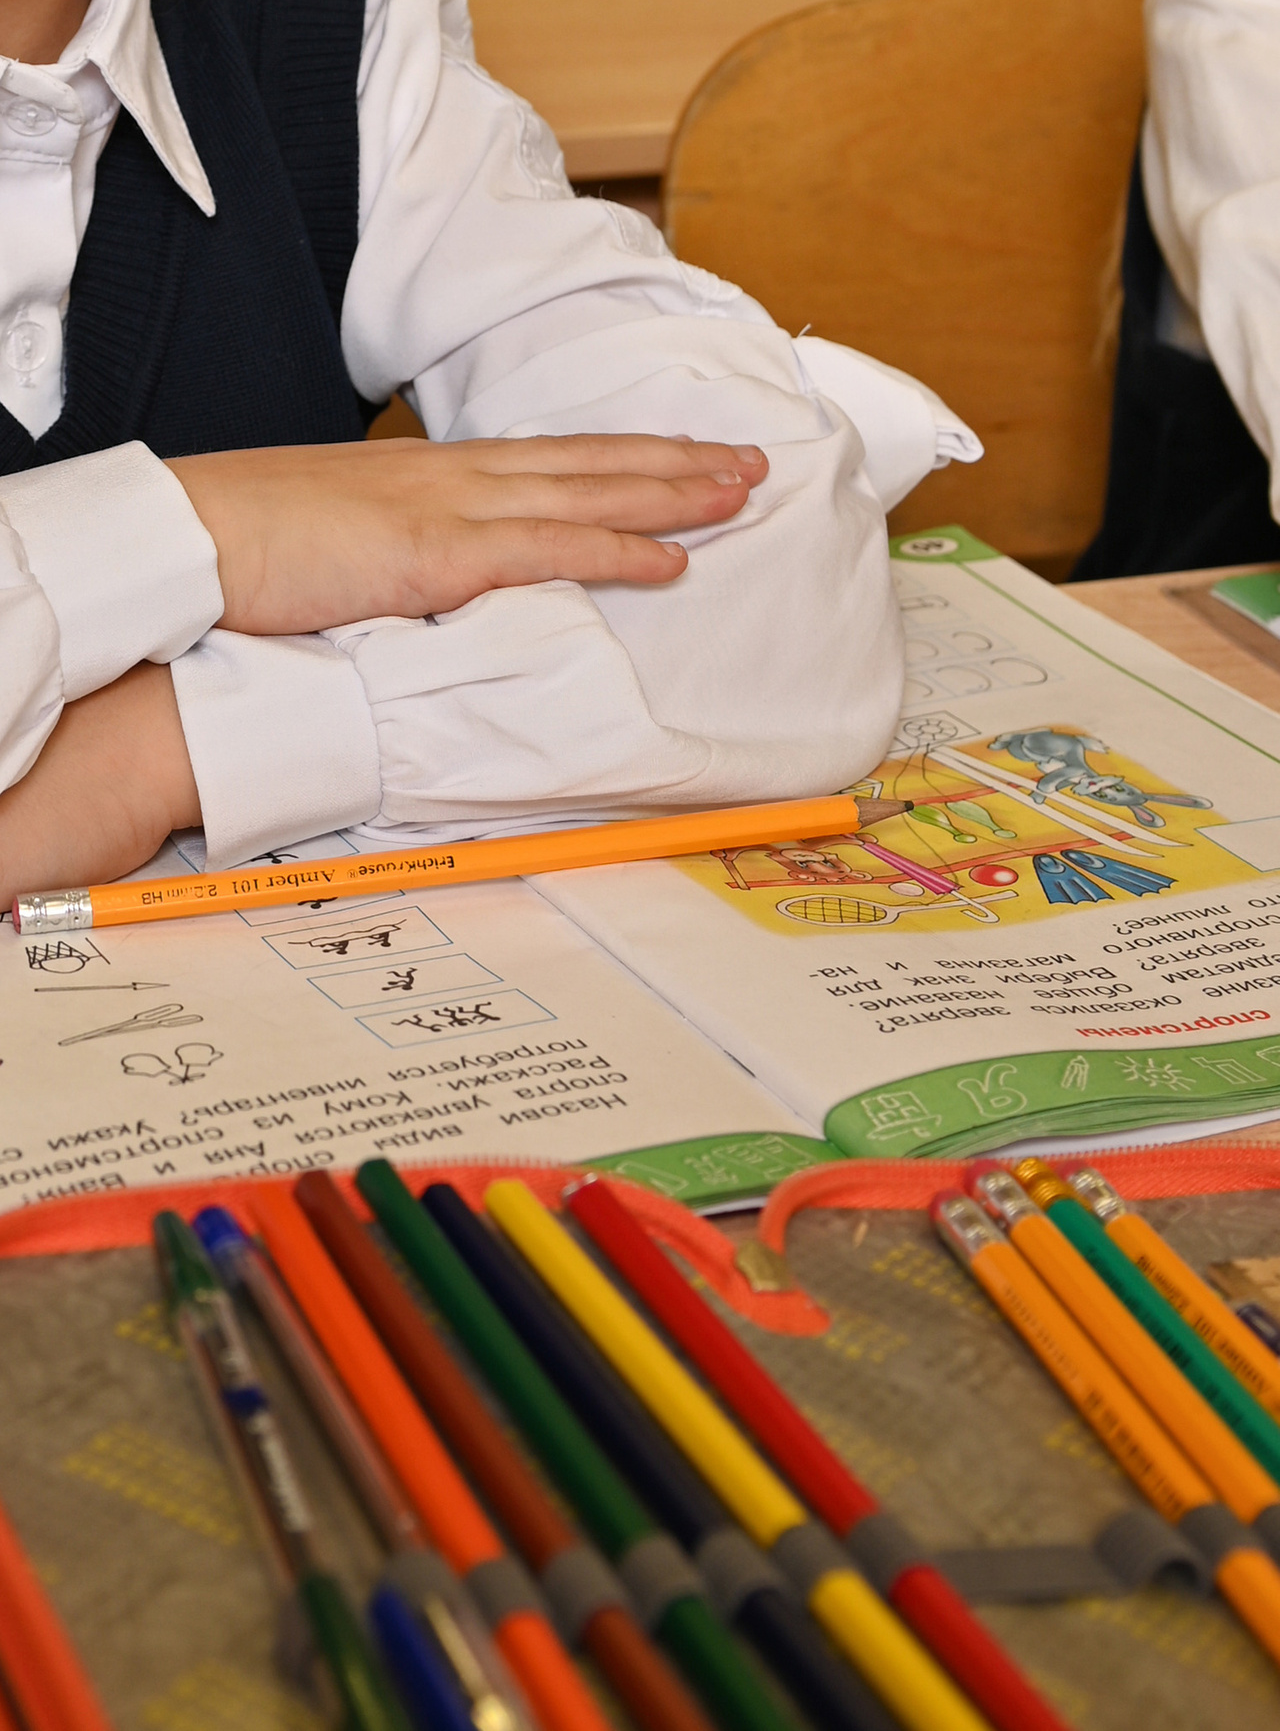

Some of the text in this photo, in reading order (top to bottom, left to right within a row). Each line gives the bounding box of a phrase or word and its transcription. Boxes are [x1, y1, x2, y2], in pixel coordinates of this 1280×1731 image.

[231, 877, 261, 895] 101
[262, 868, 336, 891] Amber
[140, 890, 163, 906] HB
[1111, 903, 1231, 937] лишнее?
[807, 914, 1280, 980] спортивного магазина и на-
[826, 937, 1266, 999] зверята? Выбери знак для
[848, 987, 1004, 1013] название.
[1030, 993, 1182, 1017] оказались
[1033, 980, 1134, 1003] общее
[874, 1006, 1011, 1034] зверята?
[1074, 1006, 1272, 1040] спортсмены
[385, 1038, 588, 1084] потребуется
[436, 1053, 611, 1093] Расскажи.
[513, 1070, 628, 1100] спорта
[179, 1076, 368, 1127] инвентарь?
[320, 1088, 413, 1117] Кому
[252, 1110, 295, 1130] из
[294, 1094, 492, 1144] увлекаются
[46, 1118, 157, 1153] Укажи
[212, 1093, 627, 1181] Назови виды спор
[203, 1141, 266, 1165] Аня
[153, 1160, 176, 1177] и
